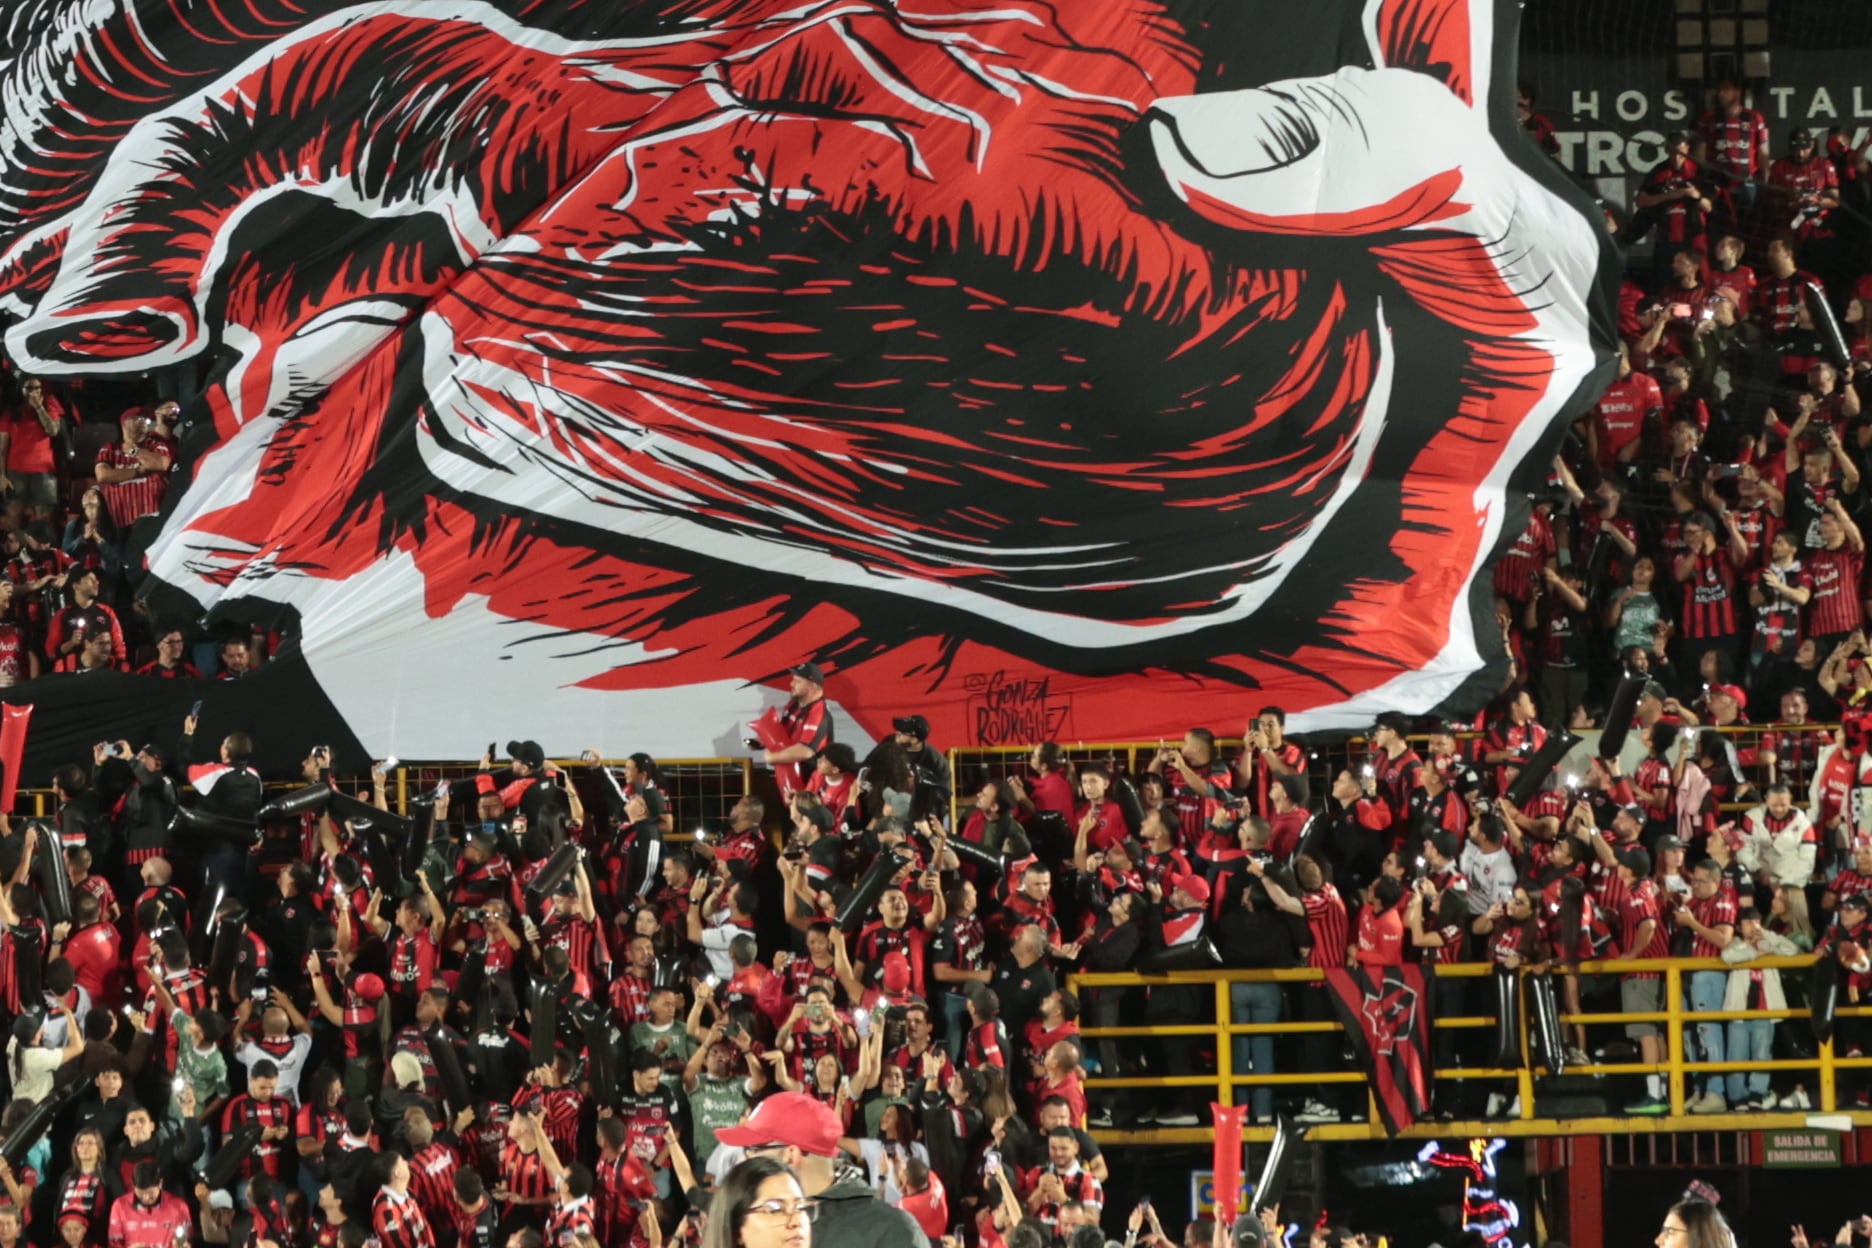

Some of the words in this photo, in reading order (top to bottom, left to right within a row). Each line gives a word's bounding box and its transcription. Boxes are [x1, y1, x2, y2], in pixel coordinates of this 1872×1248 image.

[1774, 1135, 1812, 1148] SALIDA
[1813, 1134, 1828, 1147] DE
[1767, 1149, 1836, 1163] EMERGENCIA
